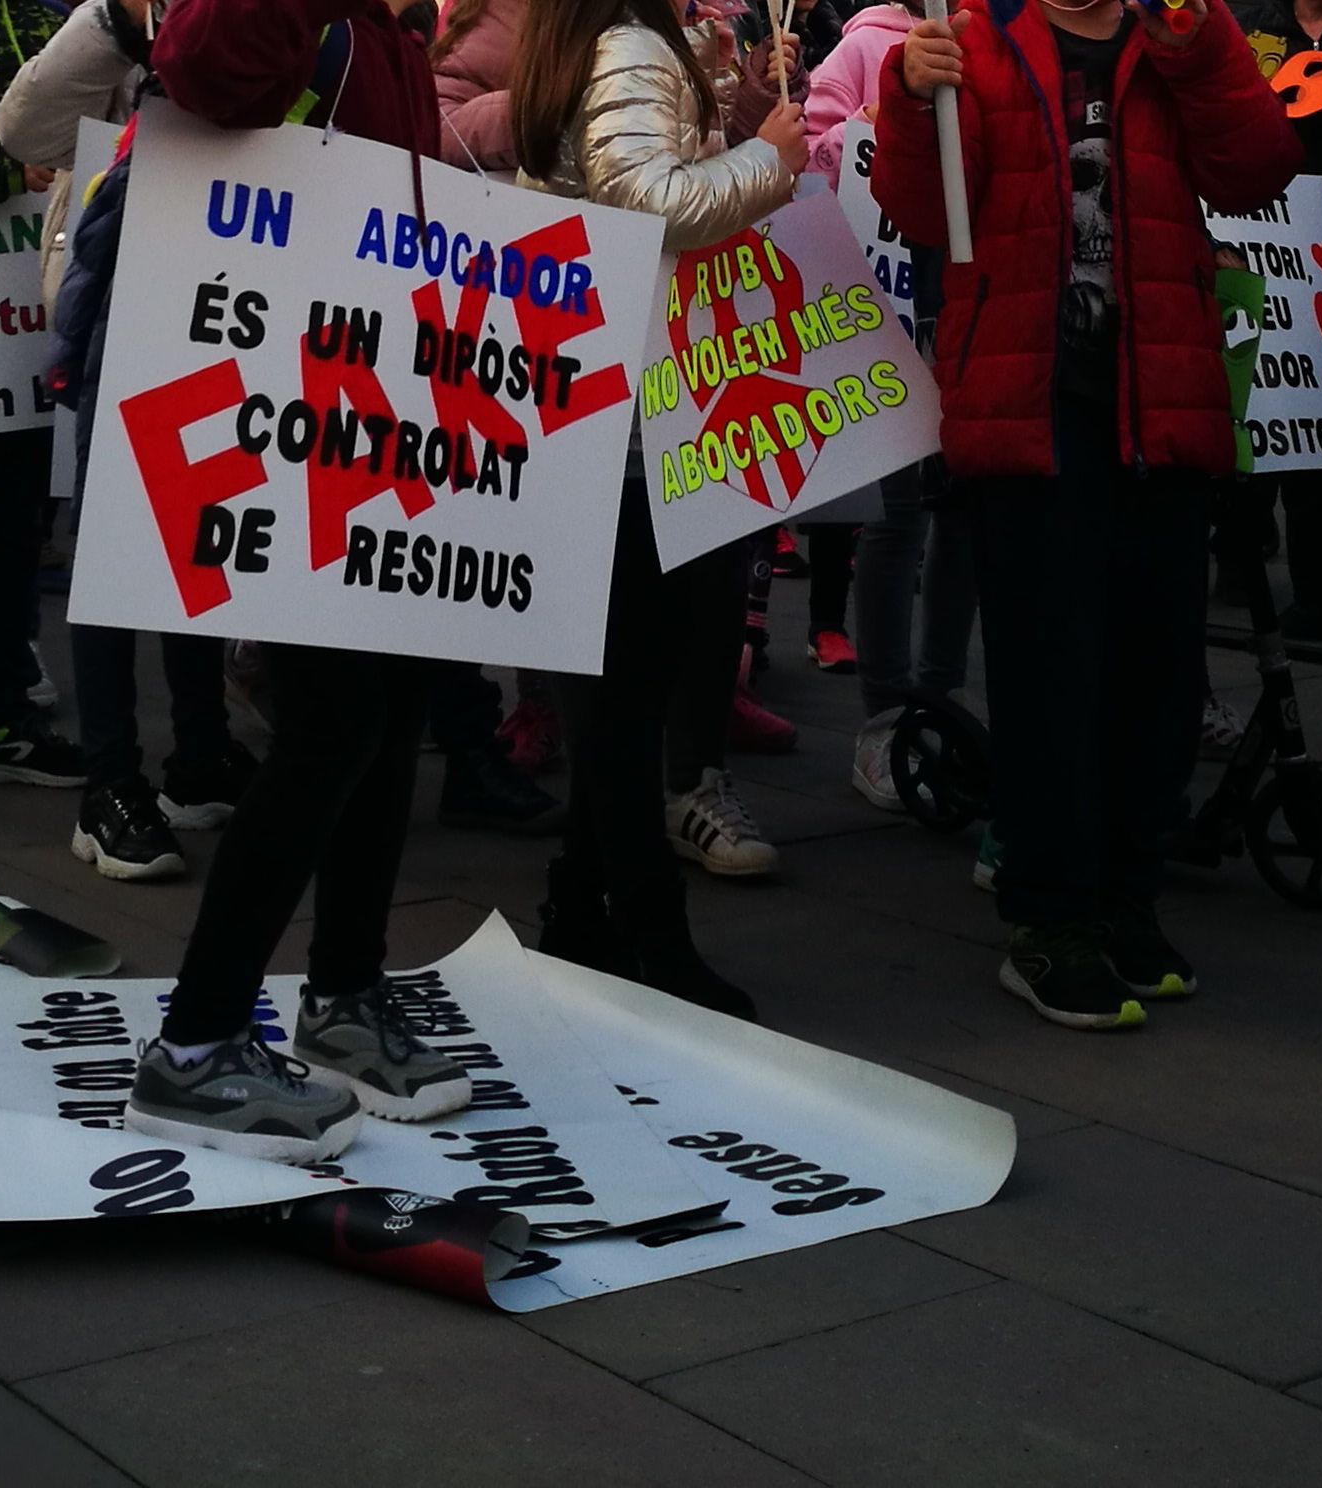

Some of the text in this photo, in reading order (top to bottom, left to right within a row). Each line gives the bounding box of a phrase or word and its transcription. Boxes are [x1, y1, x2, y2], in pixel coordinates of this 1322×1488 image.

[208, 180, 592, 313] UN ABOCADOR
[667, 223, 784, 322] A RUBÍ
[190, 272, 580, 408] ÉS UN DIPÒSIT
[642, 283, 883, 419] NO VOLEM MÉS
[237, 394, 528, 500] CONTROLAT
[662, 361, 908, 504] ABOCADORS
[194, 505, 534, 612] DE RESIDUS
[668, 1131, 885, 1216] Sense
